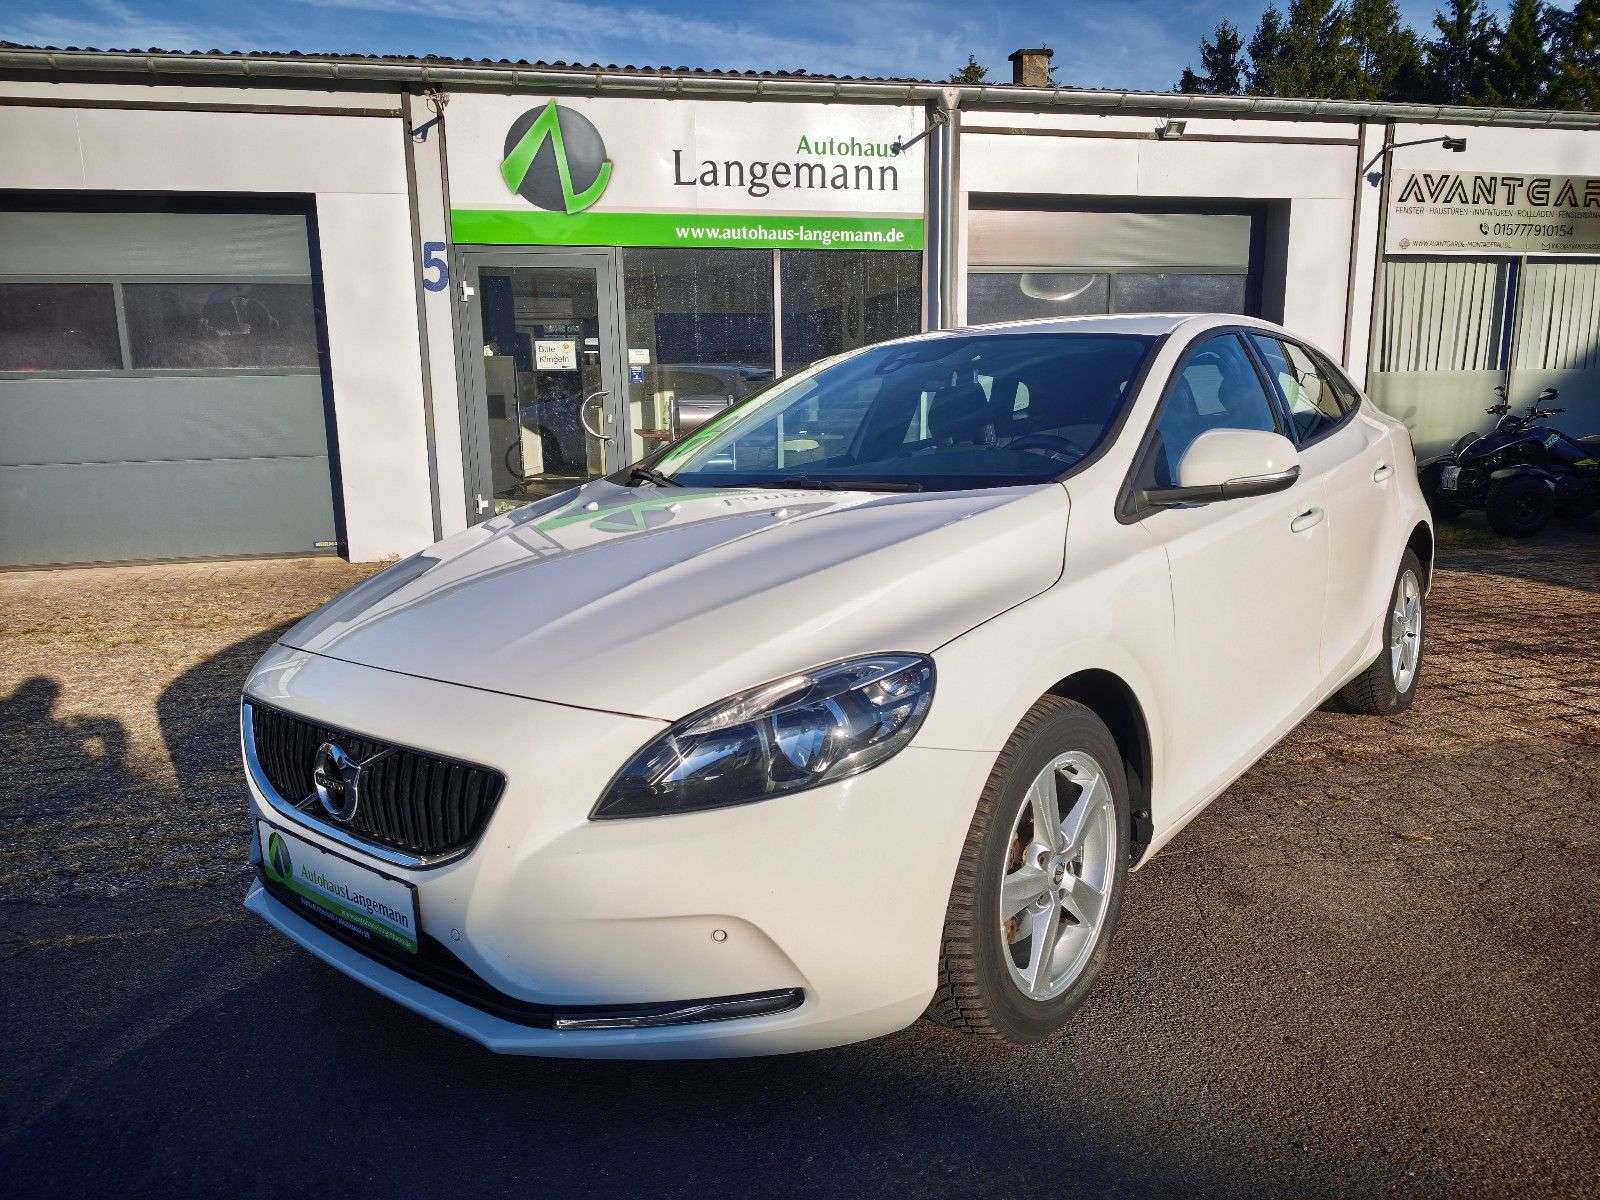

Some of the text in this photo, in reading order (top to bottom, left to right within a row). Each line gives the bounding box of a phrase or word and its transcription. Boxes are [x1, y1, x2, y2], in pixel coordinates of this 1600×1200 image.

[796, 134, 899, 157] Autohaus
[672, 149, 898, 198] Langemann
[676, 225, 905, 246] www.autohaus-langemann.de
[1493, 223, 1574, 238] 015777910154
[423, 241, 449, 292] 5
